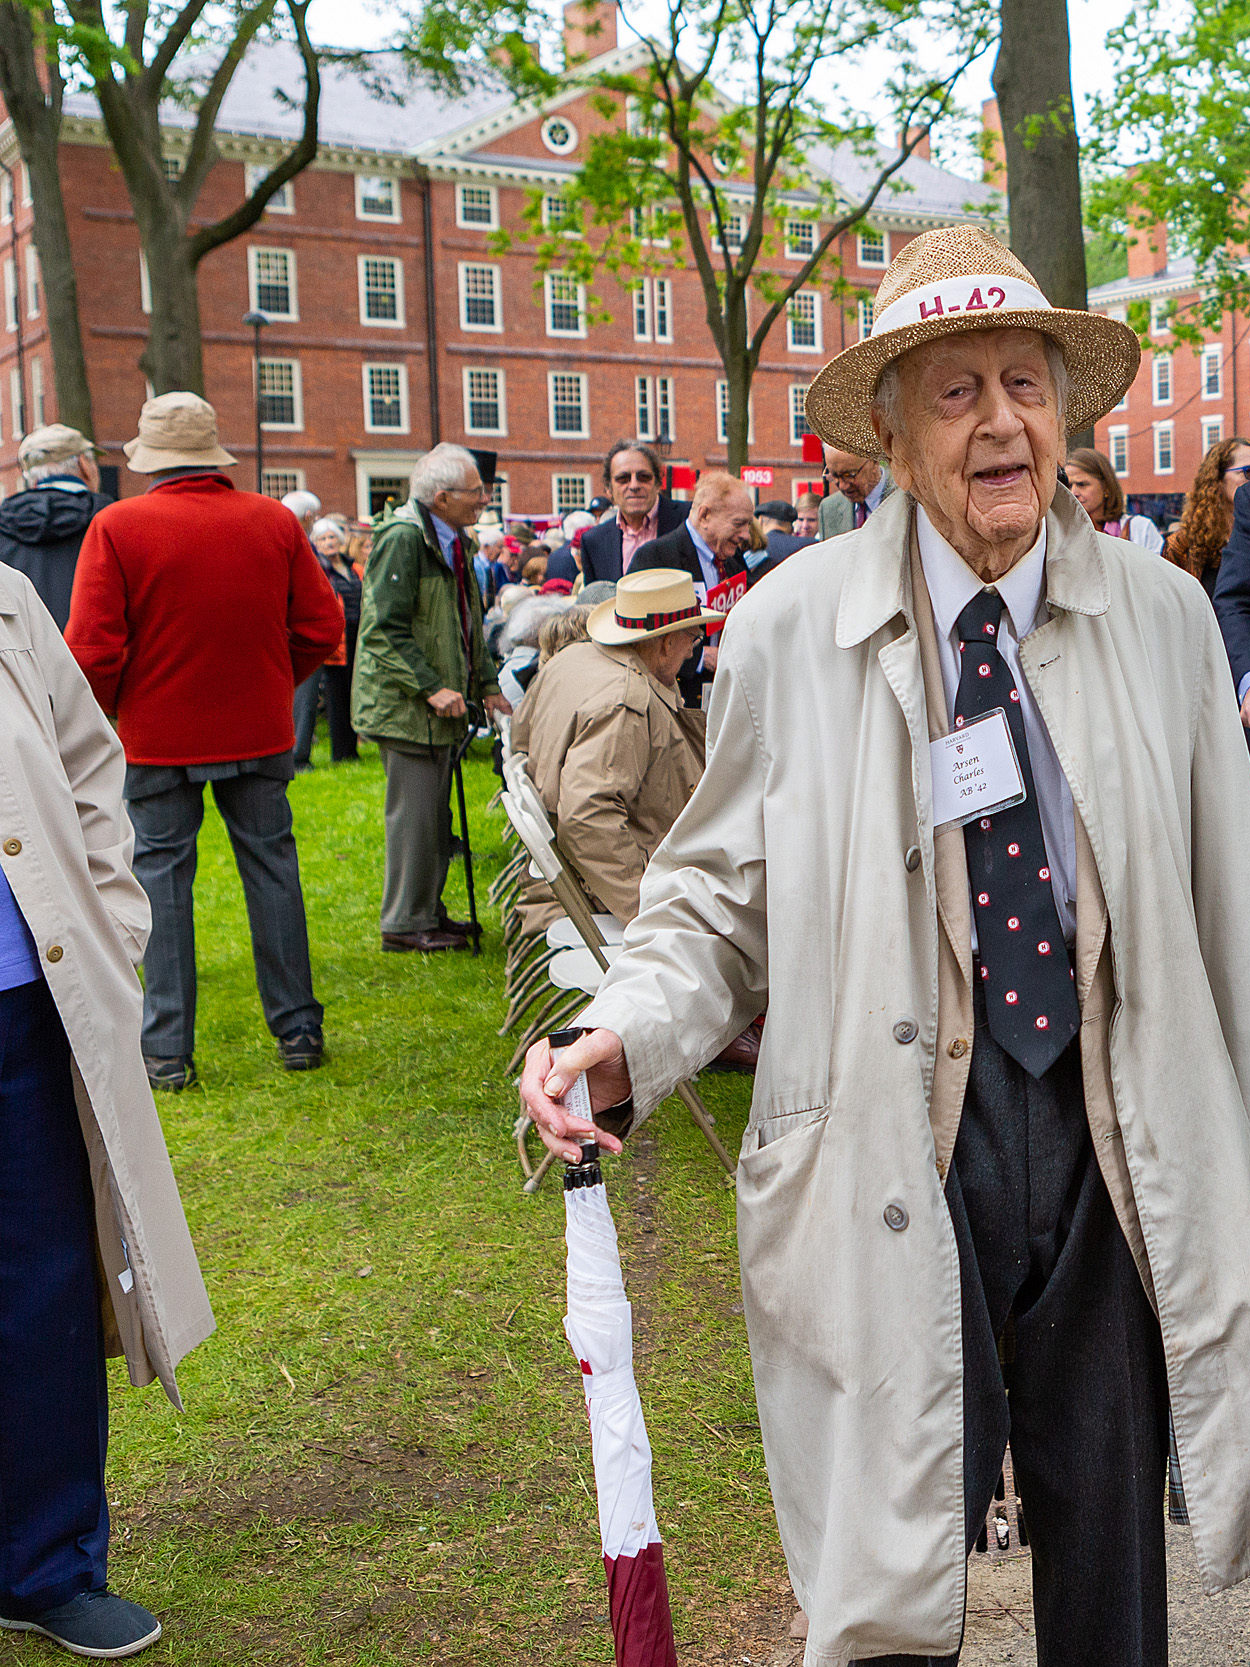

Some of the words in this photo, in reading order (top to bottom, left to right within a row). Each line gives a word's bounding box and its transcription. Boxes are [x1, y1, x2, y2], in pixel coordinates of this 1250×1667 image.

[919, 286, 1006, 320] H-42
[944, 732, 970, 746] HARVARD
[952, 755, 980, 772] Arsen
[953, 767, 985, 785] Charles
[959, 786, 974, 798] AB
